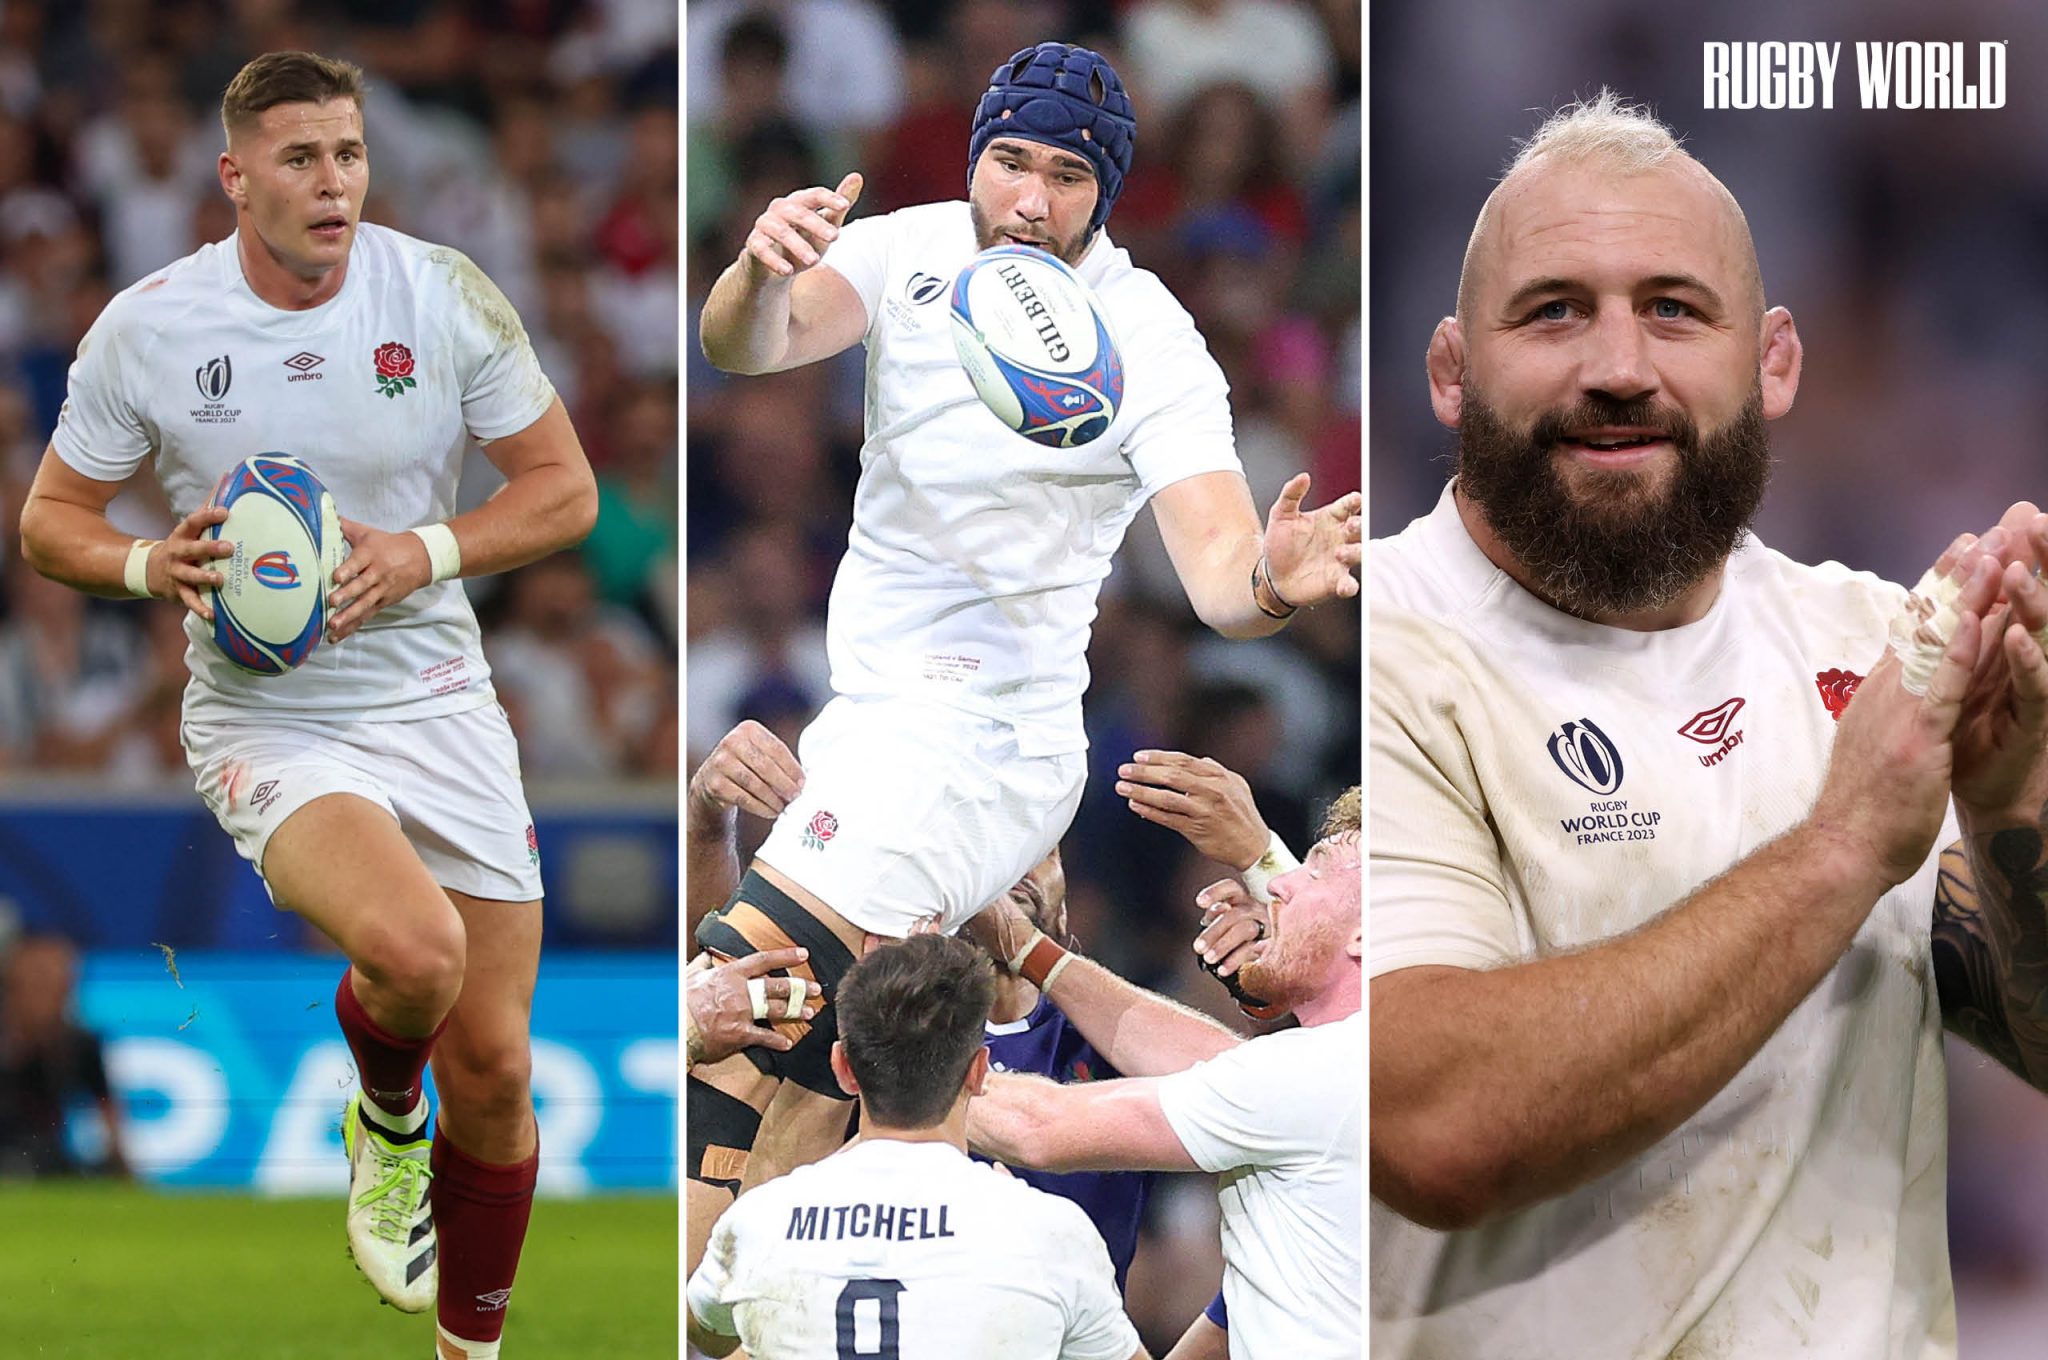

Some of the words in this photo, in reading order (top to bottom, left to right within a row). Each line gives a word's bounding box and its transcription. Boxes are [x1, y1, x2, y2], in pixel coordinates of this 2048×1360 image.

[996, 264, 1070, 363] GILBERT
[287, 372, 323, 383] umbro
[235, 540, 243, 576] WORLD
[1699, 729, 1744, 768] umbr
[257, 792, 282, 816] umbro
[1590, 800, 1628, 813] RUGBY
[1560, 814, 1628, 833] WORLD
[1631, 812, 1661, 826] CUP
[1577, 831, 1625, 845] FRANCE
[1627, 829, 1655, 841] 2023
[786, 1203, 955, 1241] MITCHELL
